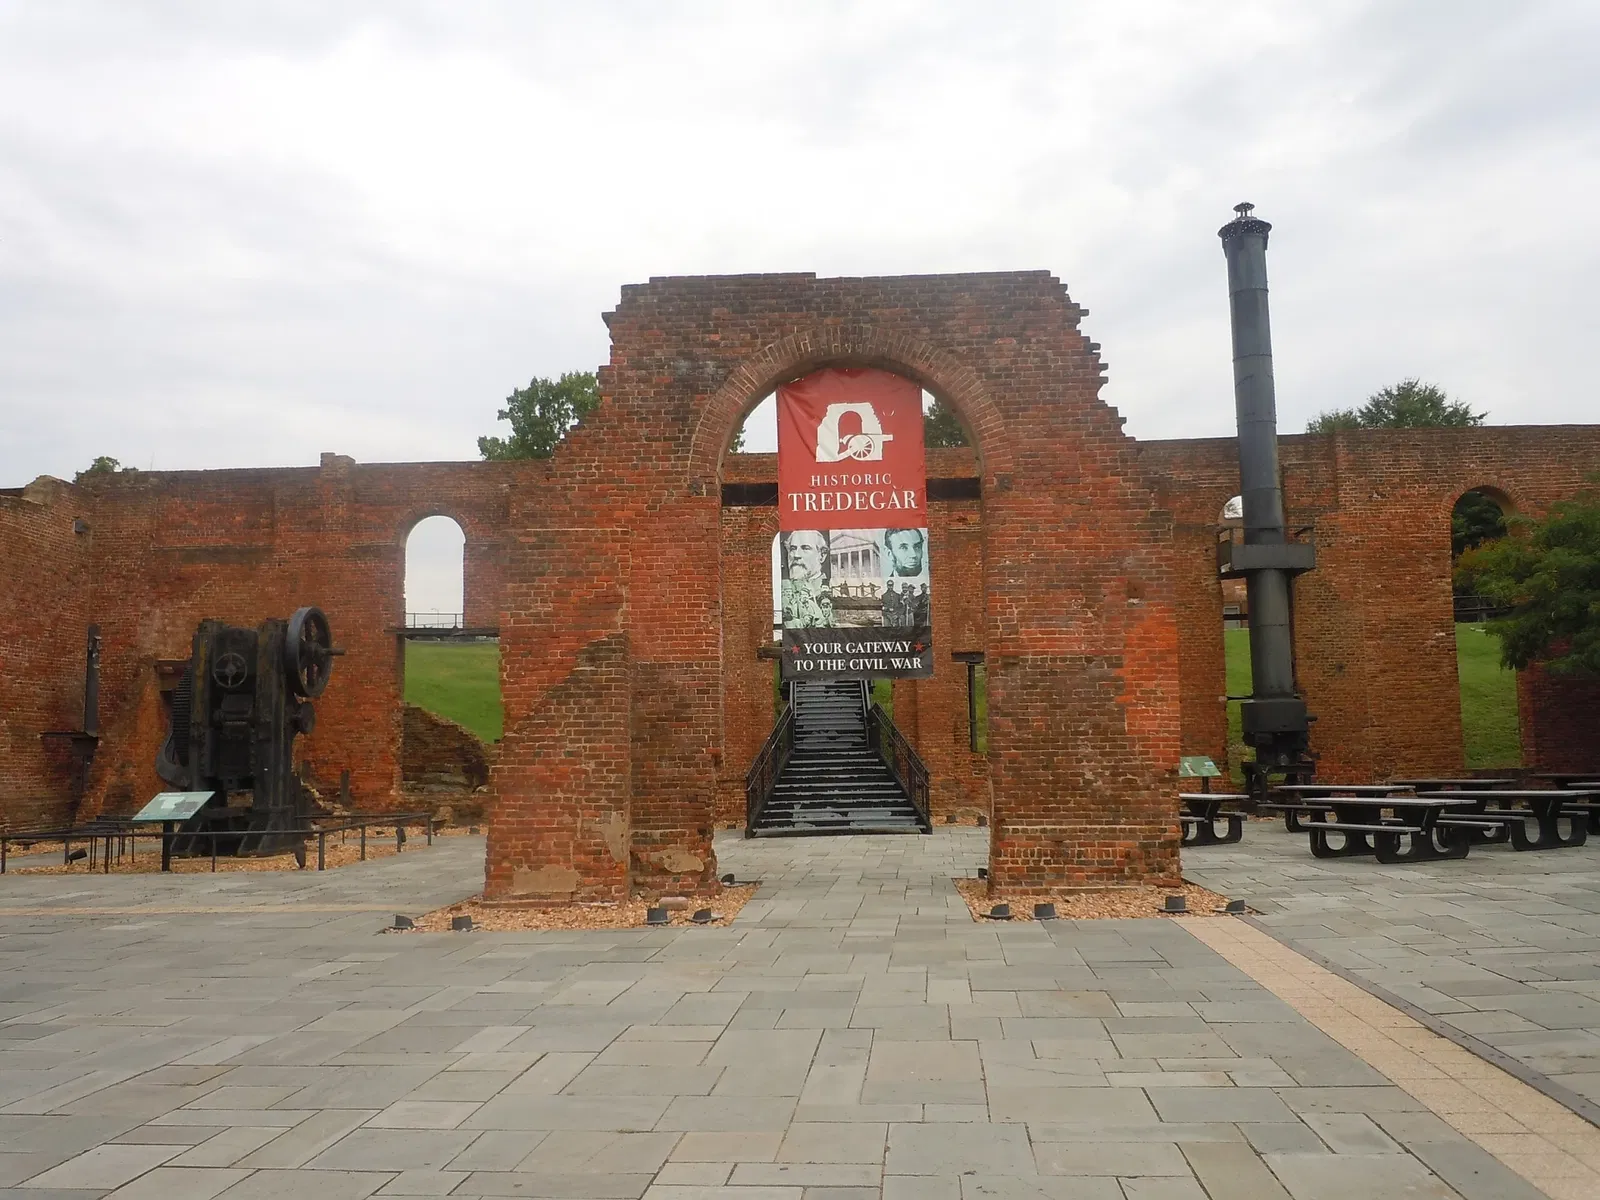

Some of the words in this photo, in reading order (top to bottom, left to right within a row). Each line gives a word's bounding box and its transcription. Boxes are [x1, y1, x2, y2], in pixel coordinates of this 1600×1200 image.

[811, 473, 892, 487] HISTORIC
[803, 642, 843, 654] YOUR
[845, 641, 911, 653] GATEWAY
[793, 660, 813, 671] TO
[816, 659, 846, 671] THE
[849, 658, 887, 670] CIVIL
[891, 658, 922, 670] WAR
